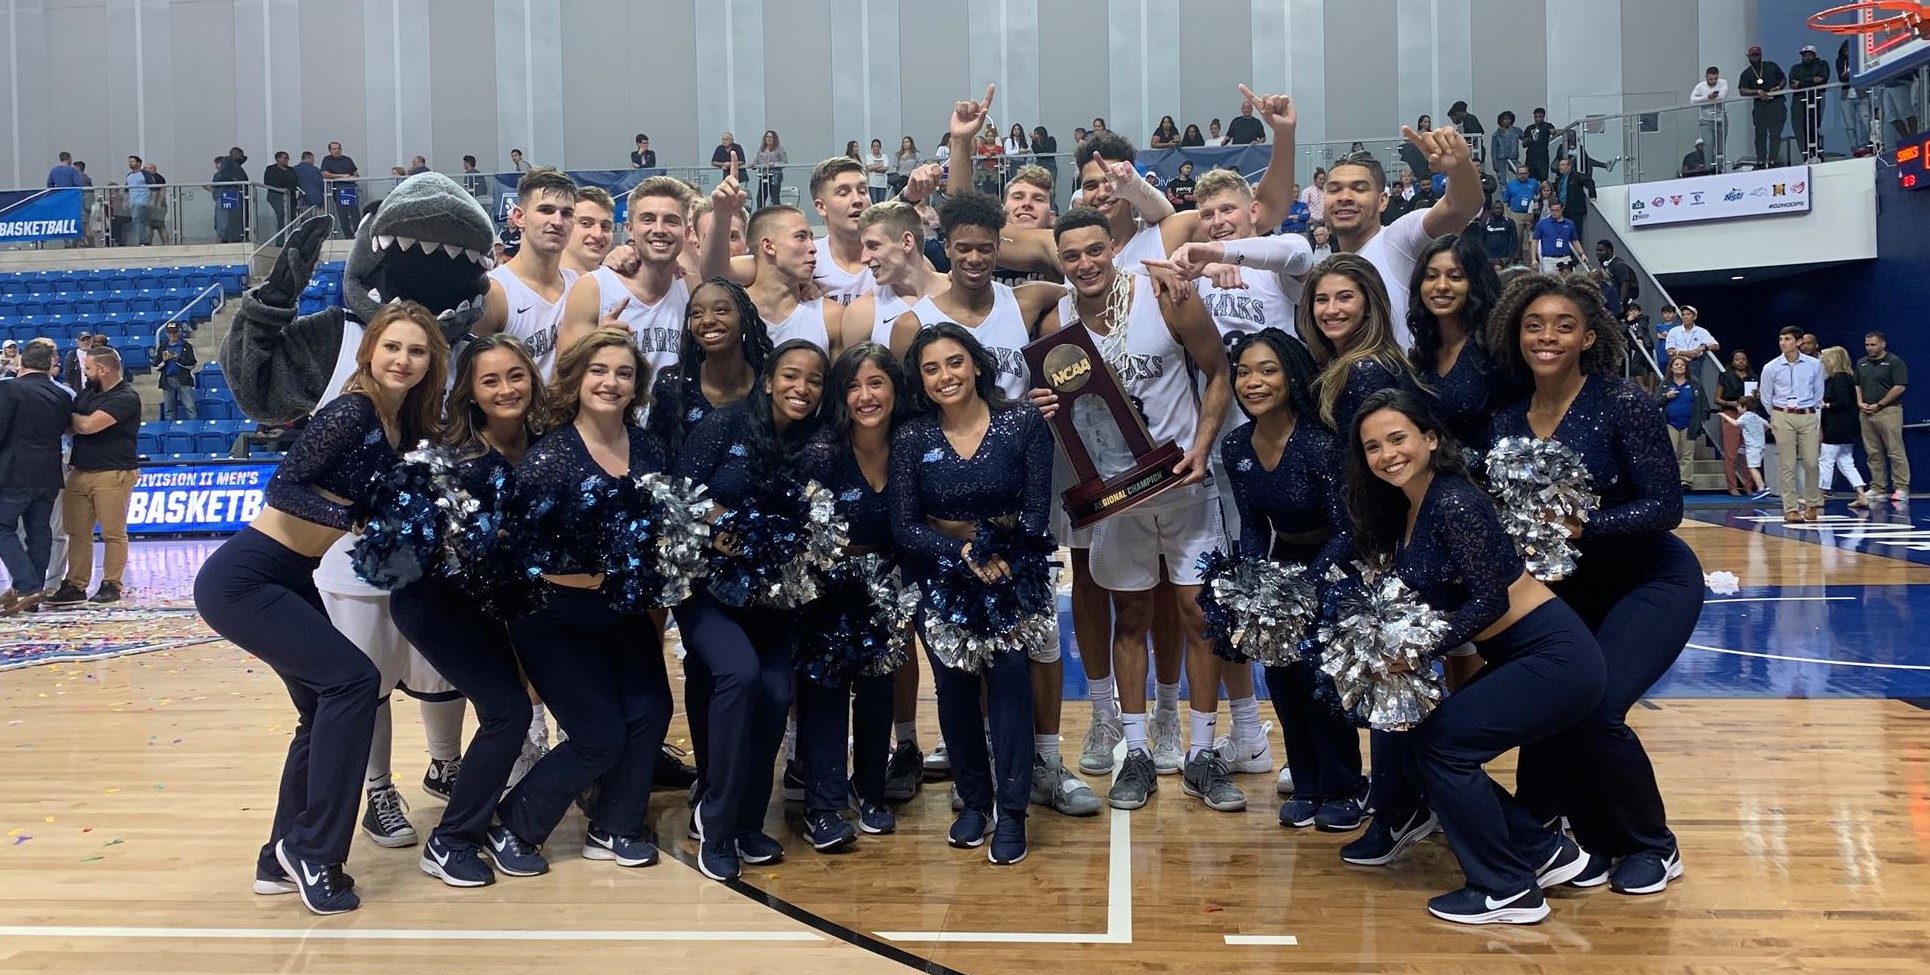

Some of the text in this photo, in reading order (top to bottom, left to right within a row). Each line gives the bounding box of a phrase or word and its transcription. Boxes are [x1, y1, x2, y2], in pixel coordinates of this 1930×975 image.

[0, 219, 78, 237] BASKETBALL
[1051, 358, 1091, 387] NCAA
[199, 472, 214, 486] II
[216, 471, 259, 485] MEN'S
[1093, 470, 1163, 511] REGIONAL CHAMPION
[126, 489, 267, 524] BASKETB
